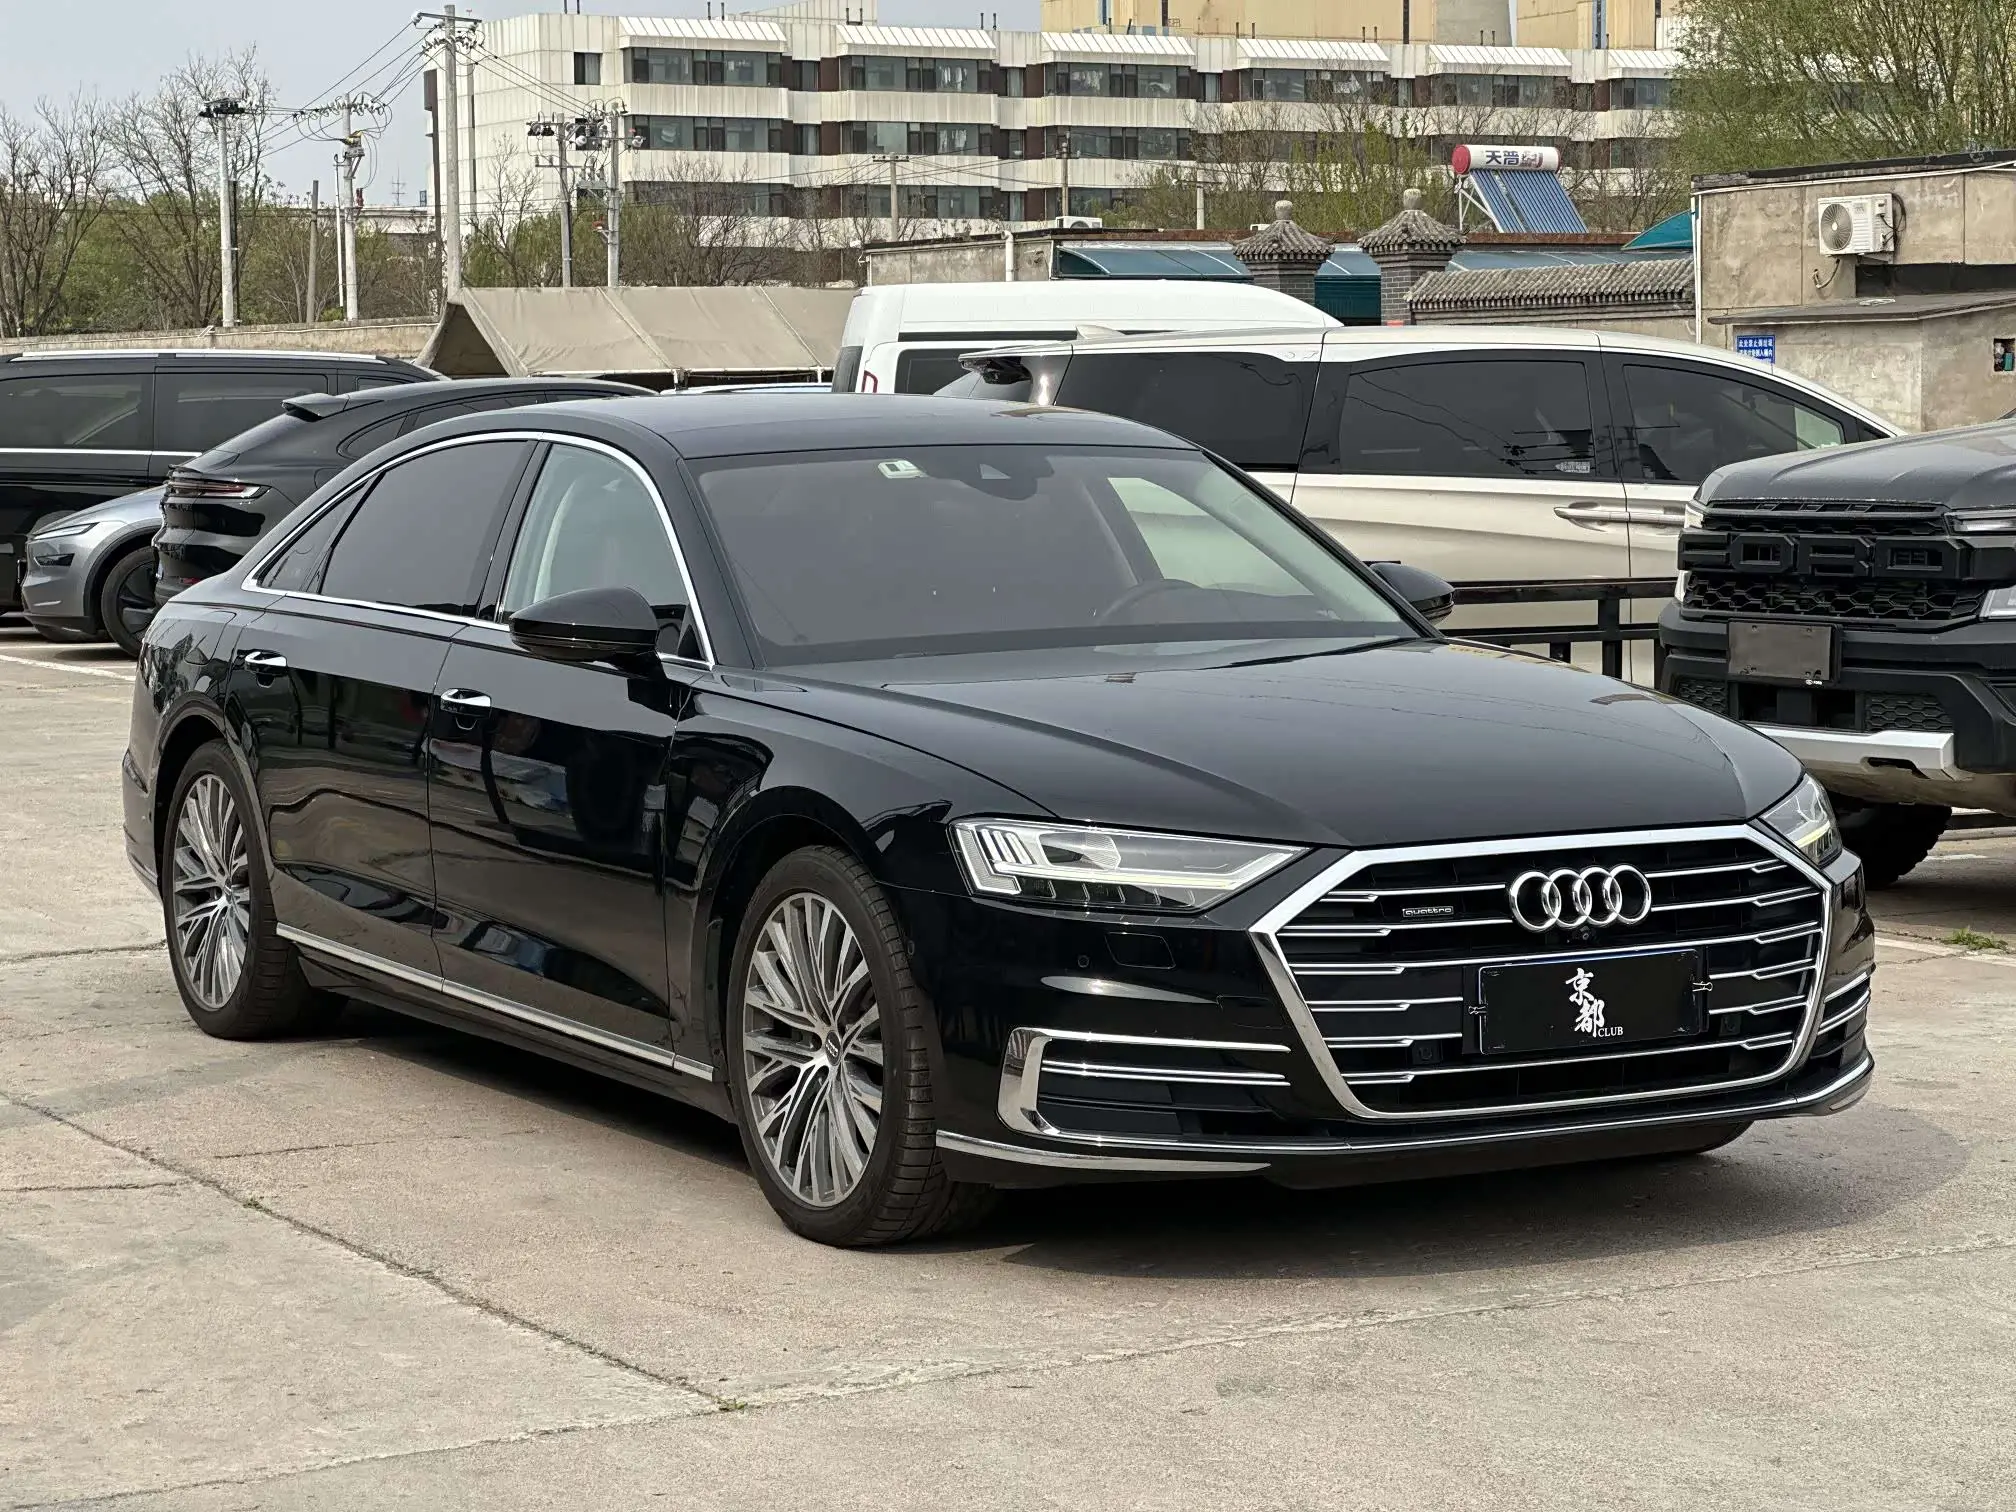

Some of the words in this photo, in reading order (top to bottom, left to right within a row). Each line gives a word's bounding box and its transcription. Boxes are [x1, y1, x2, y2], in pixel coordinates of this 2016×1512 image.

[1485, 150, 1519, 166] 天普
[1405, 907, 1452, 917] quattro
[1565, 967, 1605, 1037] 京都
[1597, 1026, 1624, 1037] CLUB
